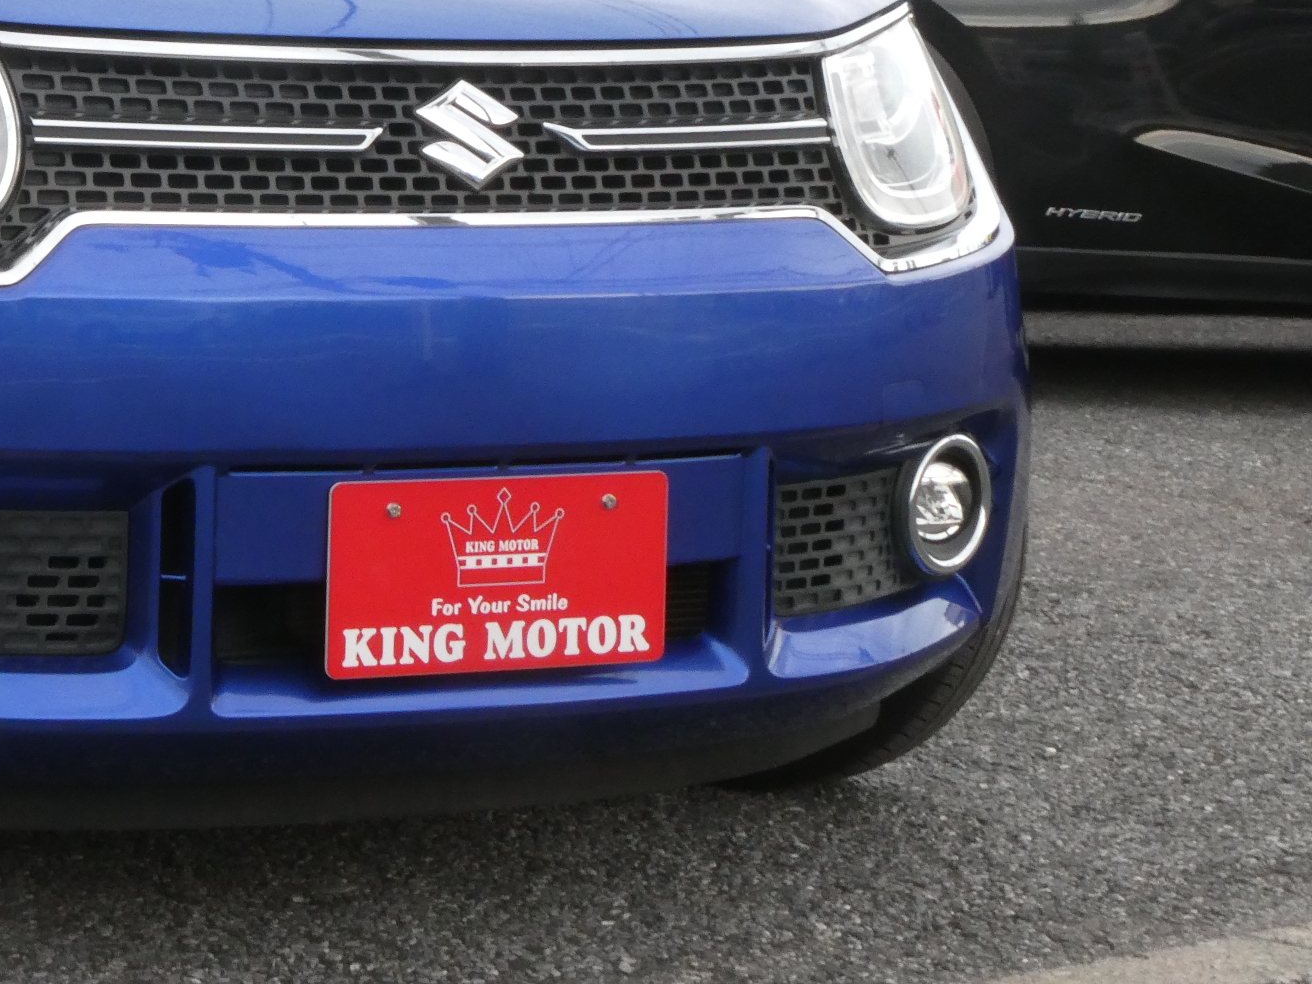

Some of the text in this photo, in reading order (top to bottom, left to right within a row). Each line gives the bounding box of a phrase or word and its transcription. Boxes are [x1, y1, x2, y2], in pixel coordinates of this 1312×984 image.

[1045, 206, 1143, 222] HYBRID
[465, 538, 539, 554] KING MOTOR
[431, 592, 569, 616] For Your Smile
[341, 614, 650, 668] KING MOTOR
